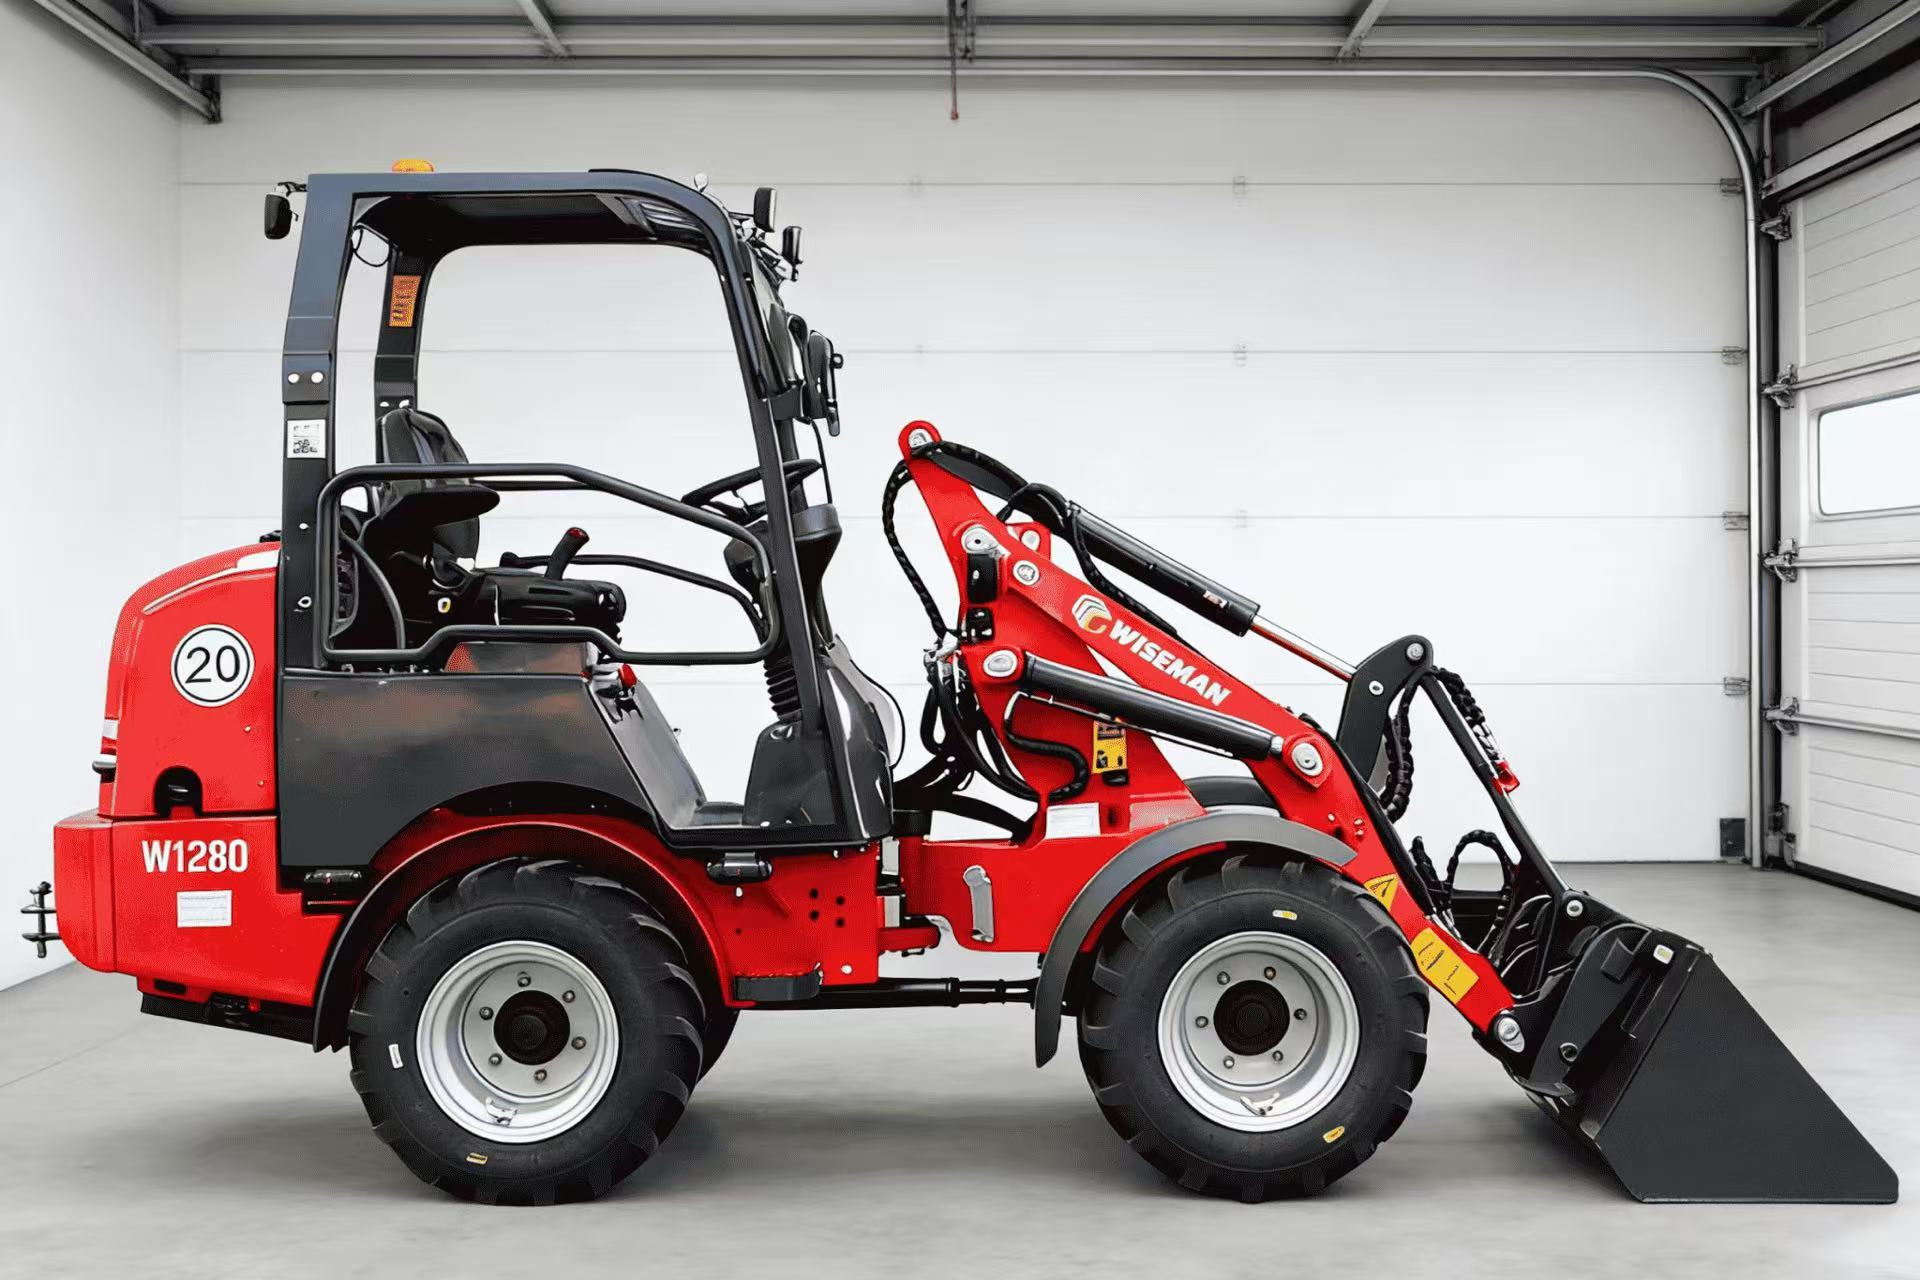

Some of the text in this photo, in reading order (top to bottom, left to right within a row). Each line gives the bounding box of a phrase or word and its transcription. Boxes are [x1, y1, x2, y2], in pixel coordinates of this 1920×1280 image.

[185, 645, 240, 683] 20
[1109, 619, 1232, 706] WISEMAN
[141, 839, 248, 873] W1280
